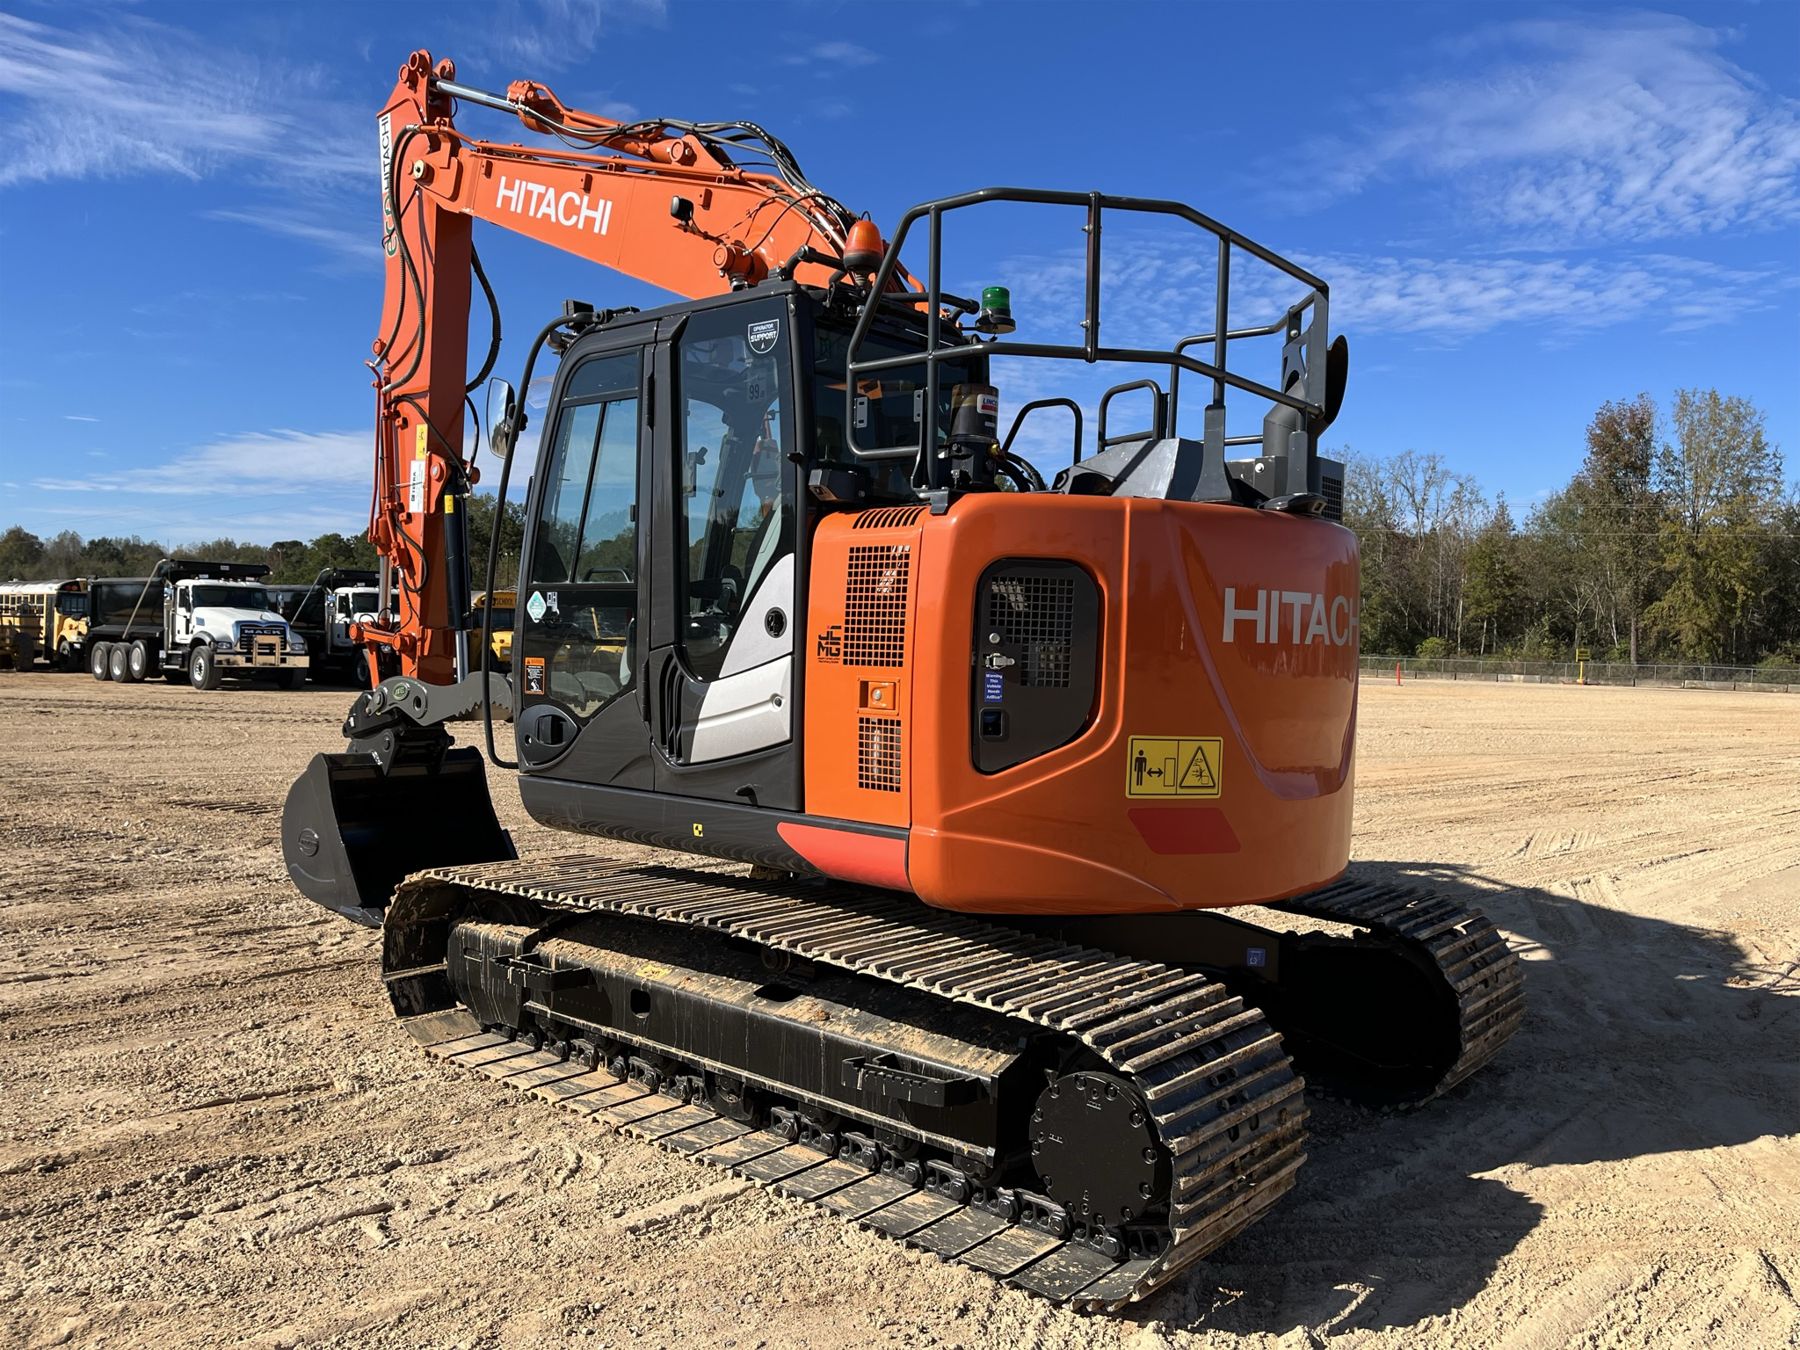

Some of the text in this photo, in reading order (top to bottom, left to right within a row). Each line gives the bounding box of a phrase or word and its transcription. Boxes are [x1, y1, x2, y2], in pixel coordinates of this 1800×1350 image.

[496, 176, 612, 236] HITACHI
[750, 331, 776, 342] SUPPORT
[749, 383, 760, 400] 99
[1222, 588, 1359, 646] HITACH
